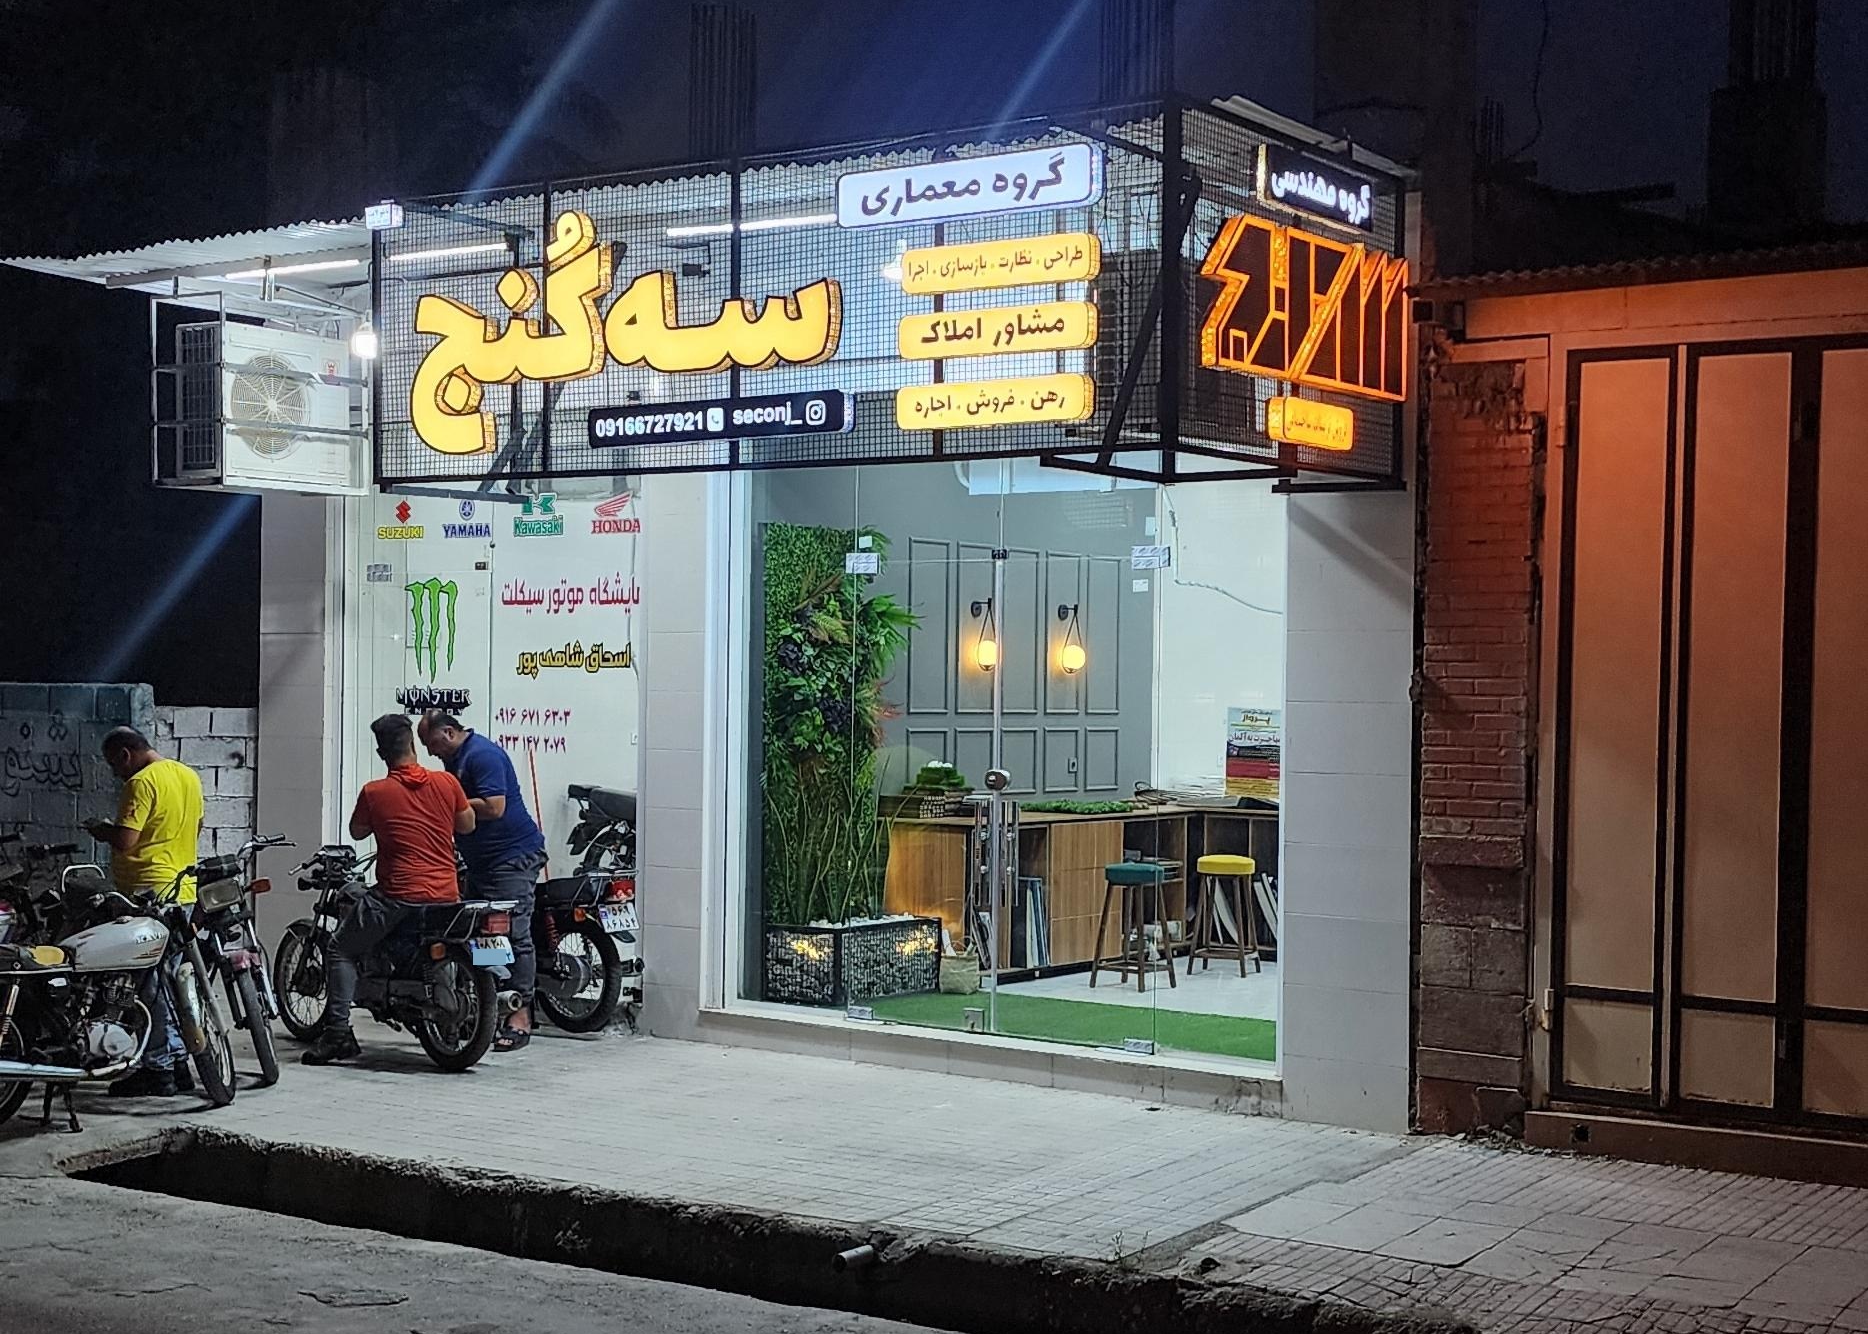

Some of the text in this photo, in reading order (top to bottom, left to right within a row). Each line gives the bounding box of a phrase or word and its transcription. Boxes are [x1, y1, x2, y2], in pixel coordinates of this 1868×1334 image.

[860, 150, 1065, 217] گروه معماری
[1271, 170, 1337, 208] مهندسی
[907, 245, 1084, 283] طراحی نظارت بازسازی اجرا
[604, 269, 843, 373] سه
[920, 307, 1066, 348] مشاور املاک
[594, 400, 804, 438] 09166727921 seconj_
[913, 389, 1066, 419] رهن فروش اجاره
[377, 514, 642, 540] SUZUKI YAMAHA Kawasaki HONDA
[516, 650, 540, 680] پور
[585, 641, 632, 673] اسحاق
[395, 685, 472, 706] MONSTER
[494, 706, 572, 727] ۰۹۱۶ ۶۷۱ ۶۳۰۳
[522, 735, 540, 752] ۱۴۷
[543, 736, 567, 754] ۲۰۷۹
